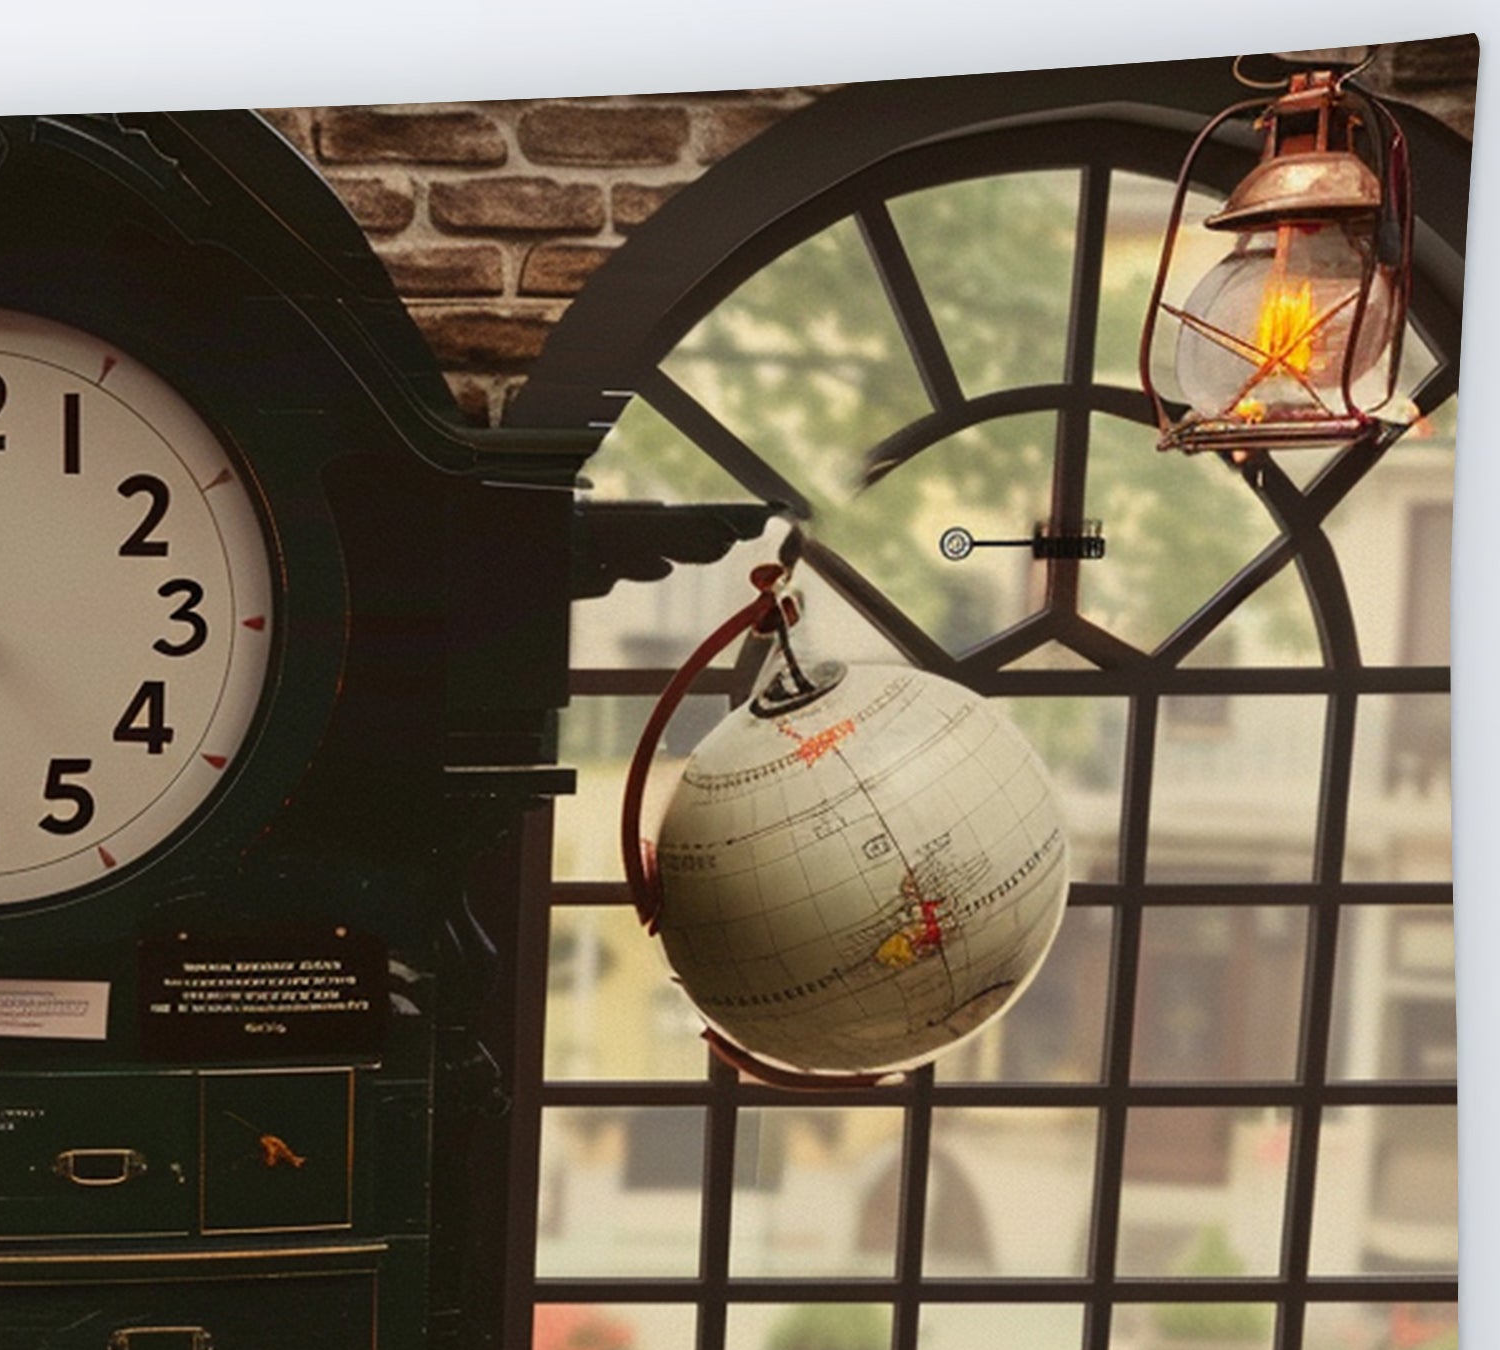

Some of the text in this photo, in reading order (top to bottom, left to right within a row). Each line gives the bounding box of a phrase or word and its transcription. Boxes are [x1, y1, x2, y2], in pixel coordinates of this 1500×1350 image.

[63, 393, 81, 474] 1
[117, 474, 170, 557] 2
[153, 578, 208, 657] 3
[112, 680, 174, 755] 4
[38, 758, 95, 835] 5
